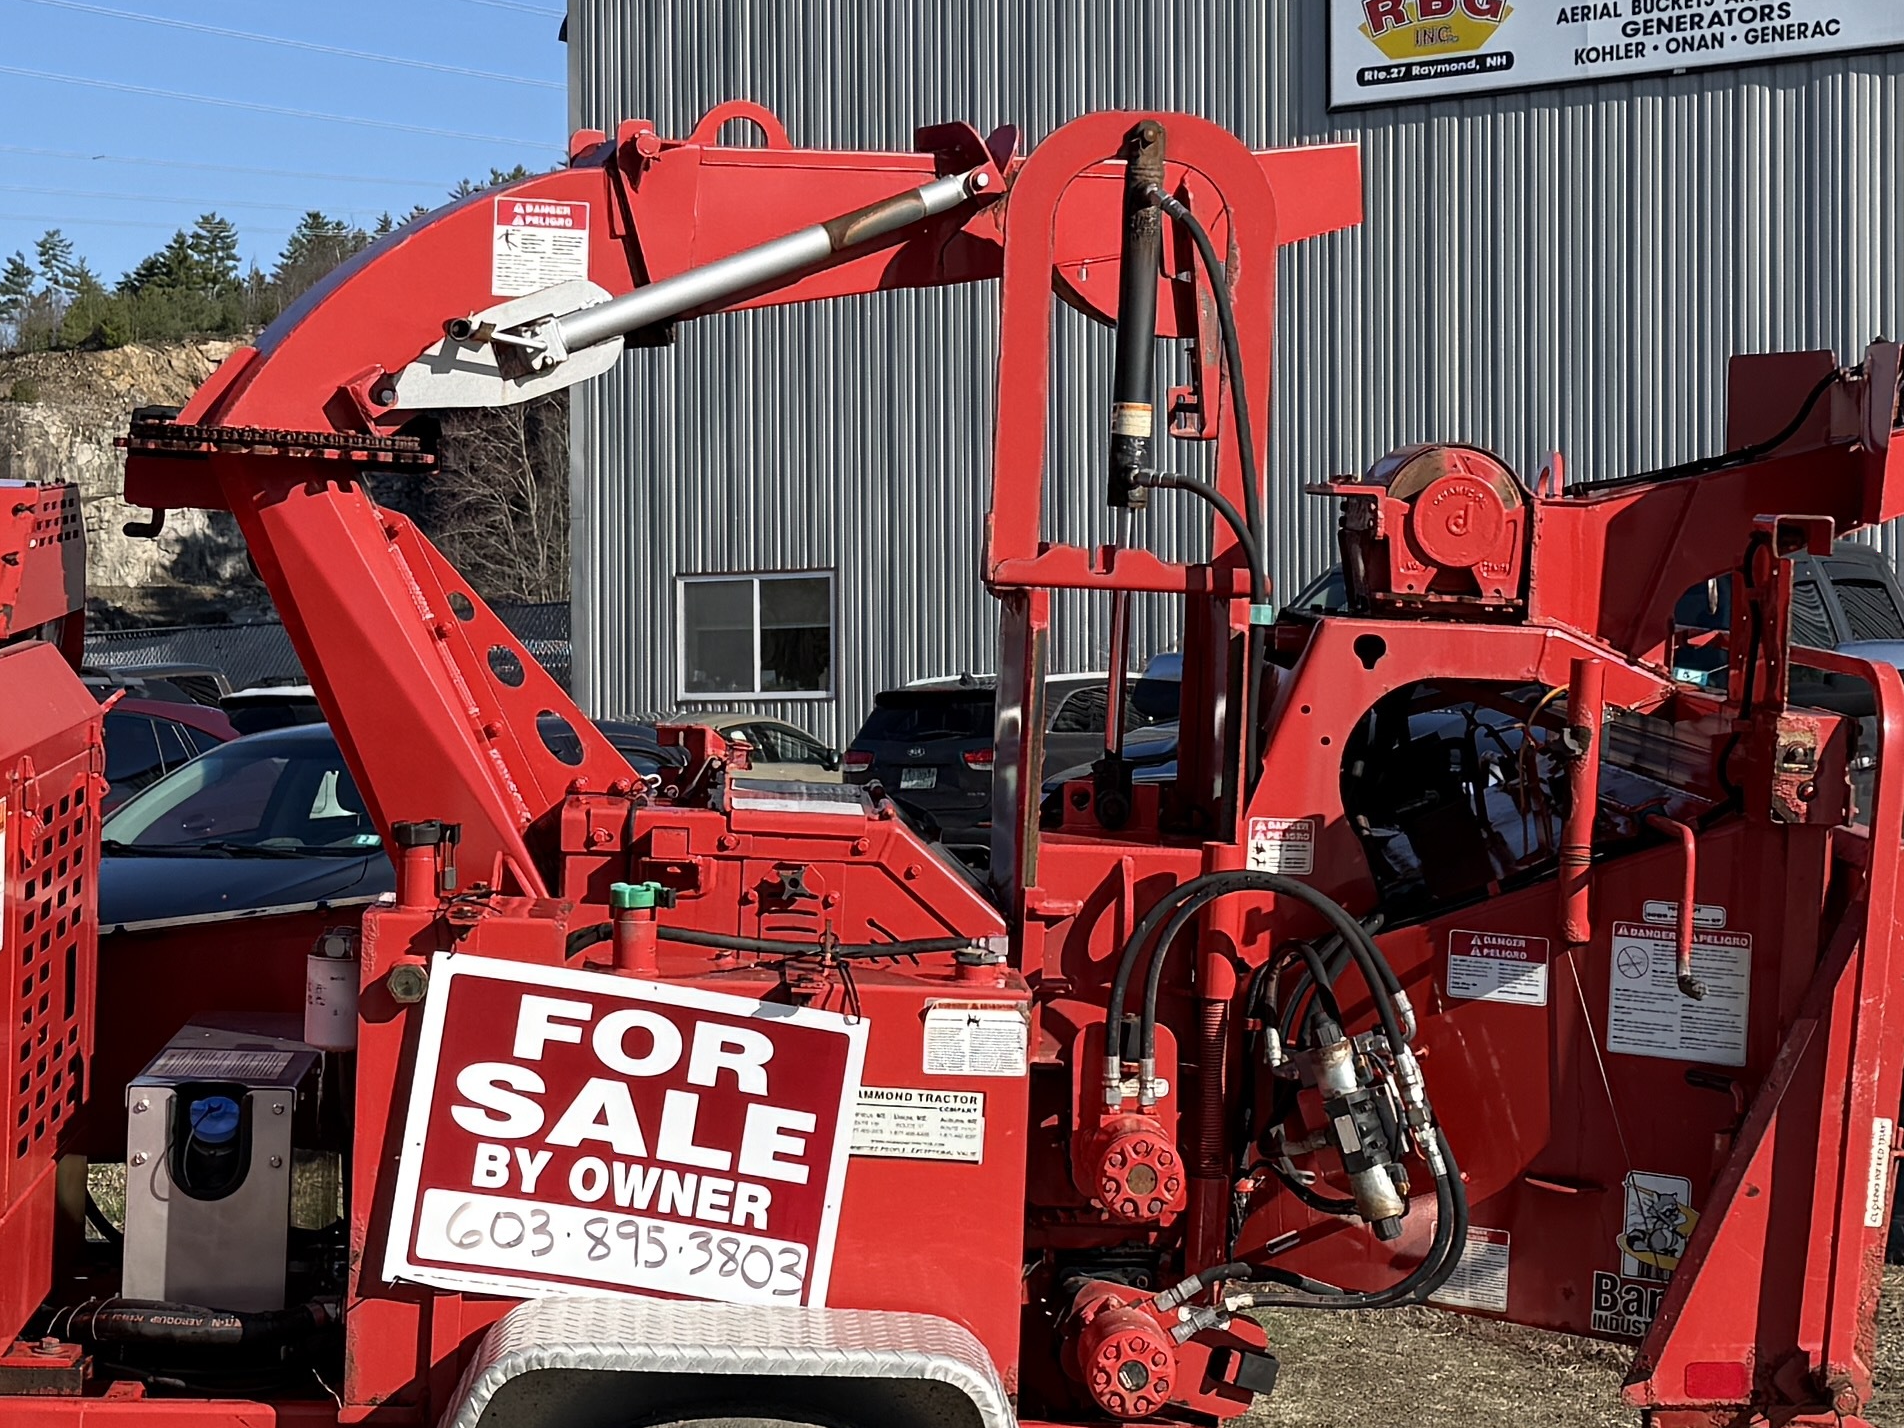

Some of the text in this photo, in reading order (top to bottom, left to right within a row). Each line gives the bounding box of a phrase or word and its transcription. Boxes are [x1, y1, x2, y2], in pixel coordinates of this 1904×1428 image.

[1556, 1, 1622, 25] AERIAL
[1621, 1, 1792, 38] GENERATORS
[1574, 19, 1841, 66] KOHLER ONAN GENERAC
[1411, 58, 1480, 77] Raymond,
[1485, 54, 1507, 68] NH
[512, 993, 775, 1097] FOR
[917, 1092, 978, 1105] TRACTOR
[450, 1061, 817, 1185] SALE
[471, 1142, 773, 1231] BY OWNER
